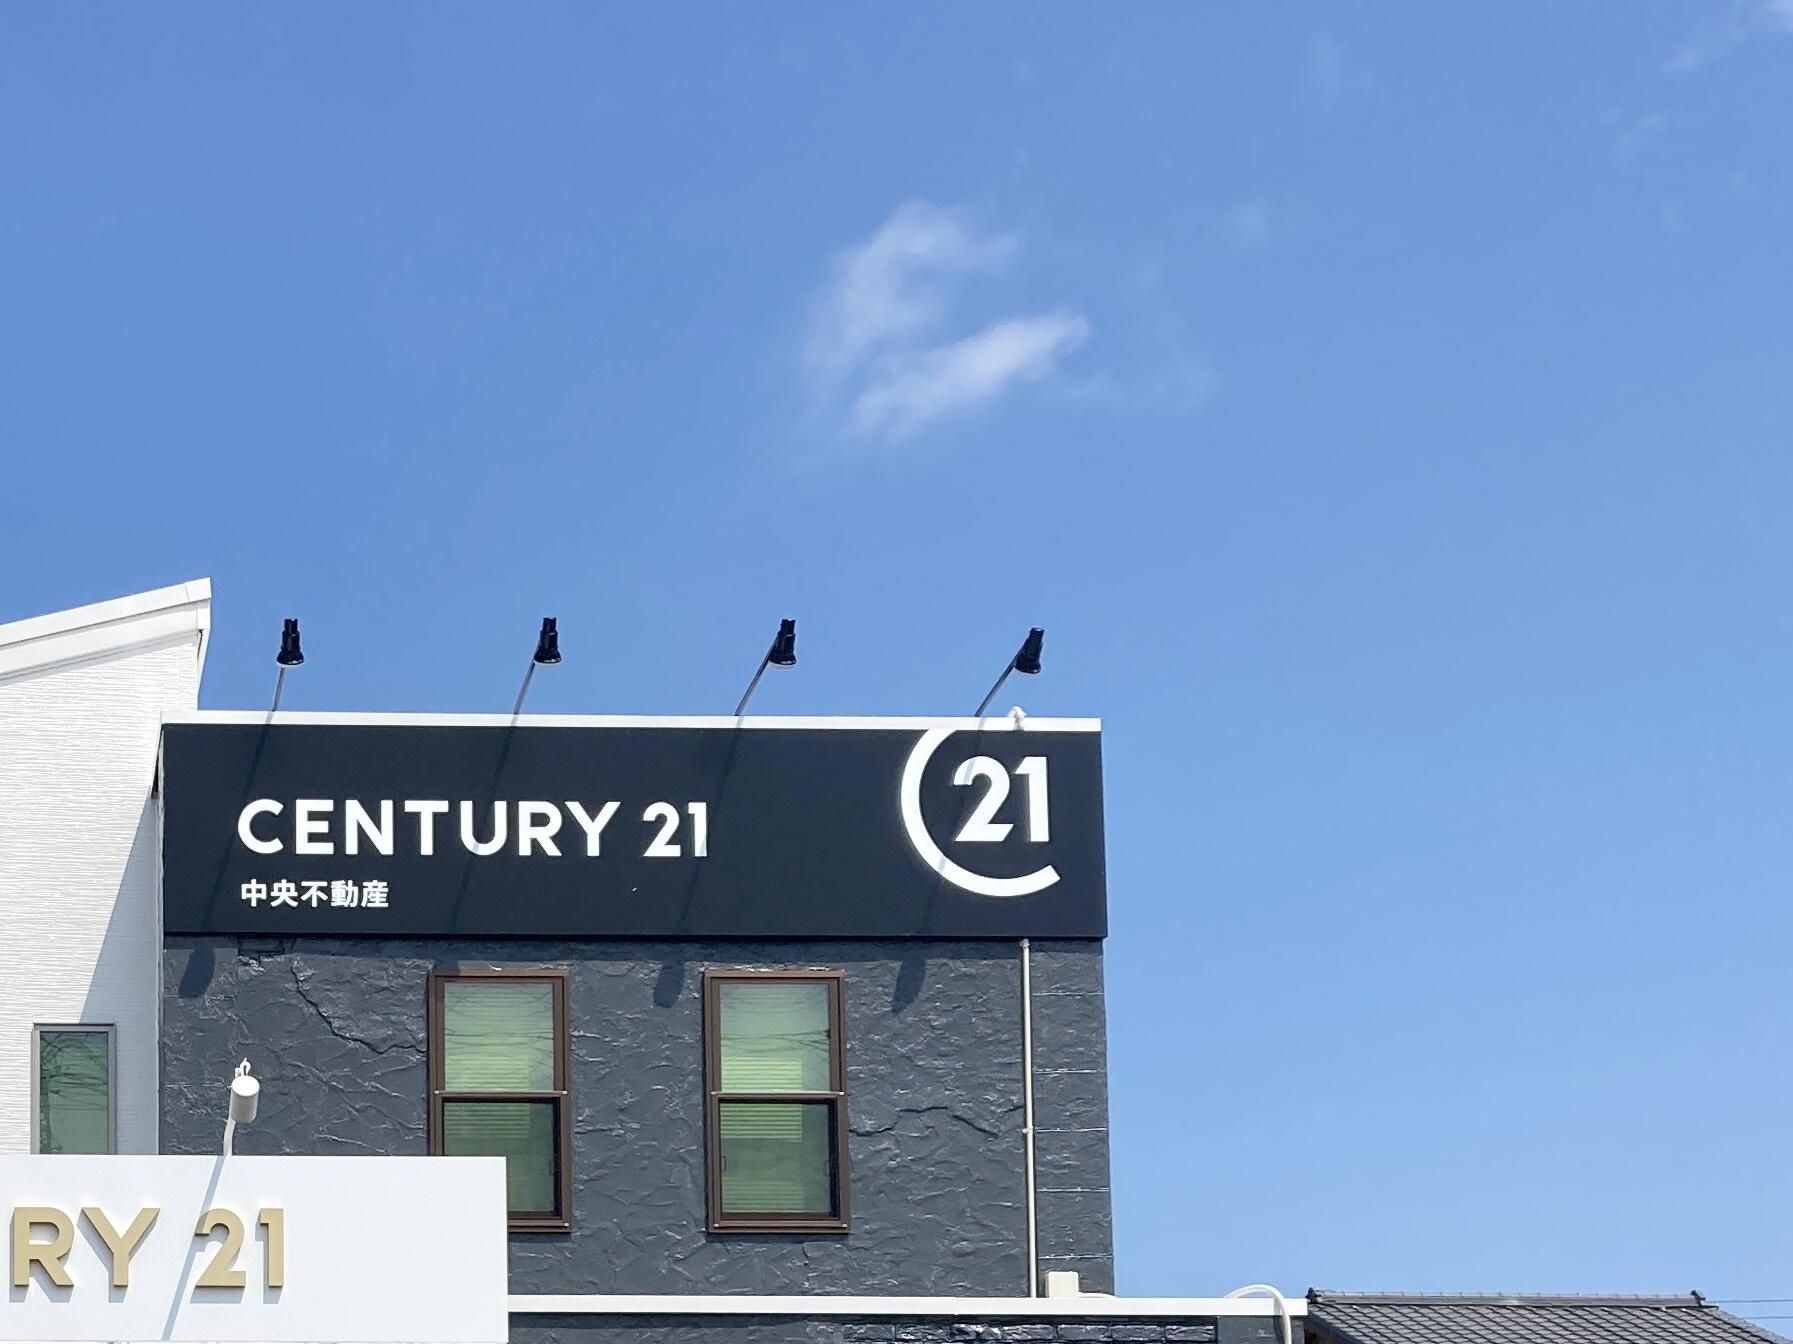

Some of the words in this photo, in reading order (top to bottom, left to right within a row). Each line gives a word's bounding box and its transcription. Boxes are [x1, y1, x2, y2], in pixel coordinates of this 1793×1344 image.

[237, 798, 621, 857] CENTURY
[642, 802, 709, 858] 21
[240, 878, 389, 908] 中央不動産
[194, 1207, 285, 1288] 21
